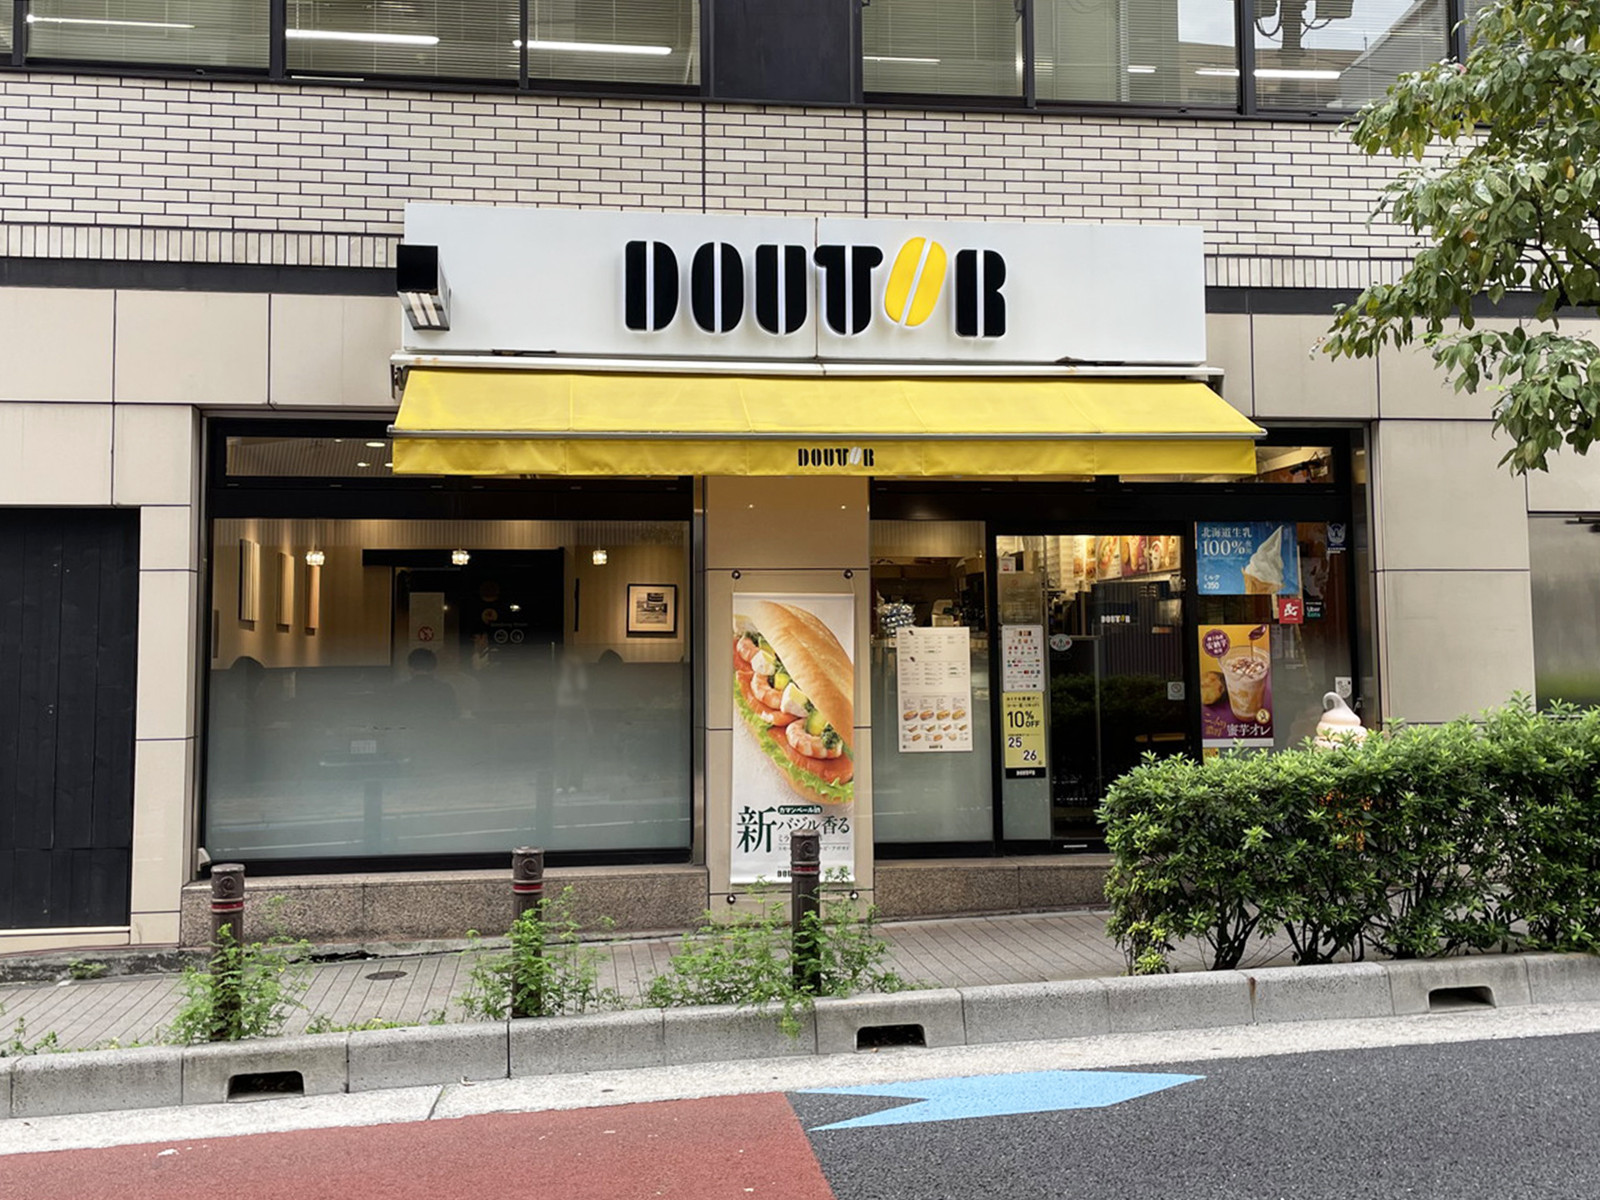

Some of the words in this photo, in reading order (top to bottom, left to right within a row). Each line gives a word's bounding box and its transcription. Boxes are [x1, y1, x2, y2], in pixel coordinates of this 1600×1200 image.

[625, 237, 1006, 338] DOUTOR
[798, 446, 874, 467] DOUTOR
[1202, 527, 1252, 538] 北海道生乳
[1203, 540, 1245, 556] 100%
[1007, 710, 1034, 728] 10%
[1008, 737, 1022, 748] 25
[1023, 750, 1036, 761] 26
[736, 805, 777, 853] 新
[778, 816, 850, 835] バジル香る
